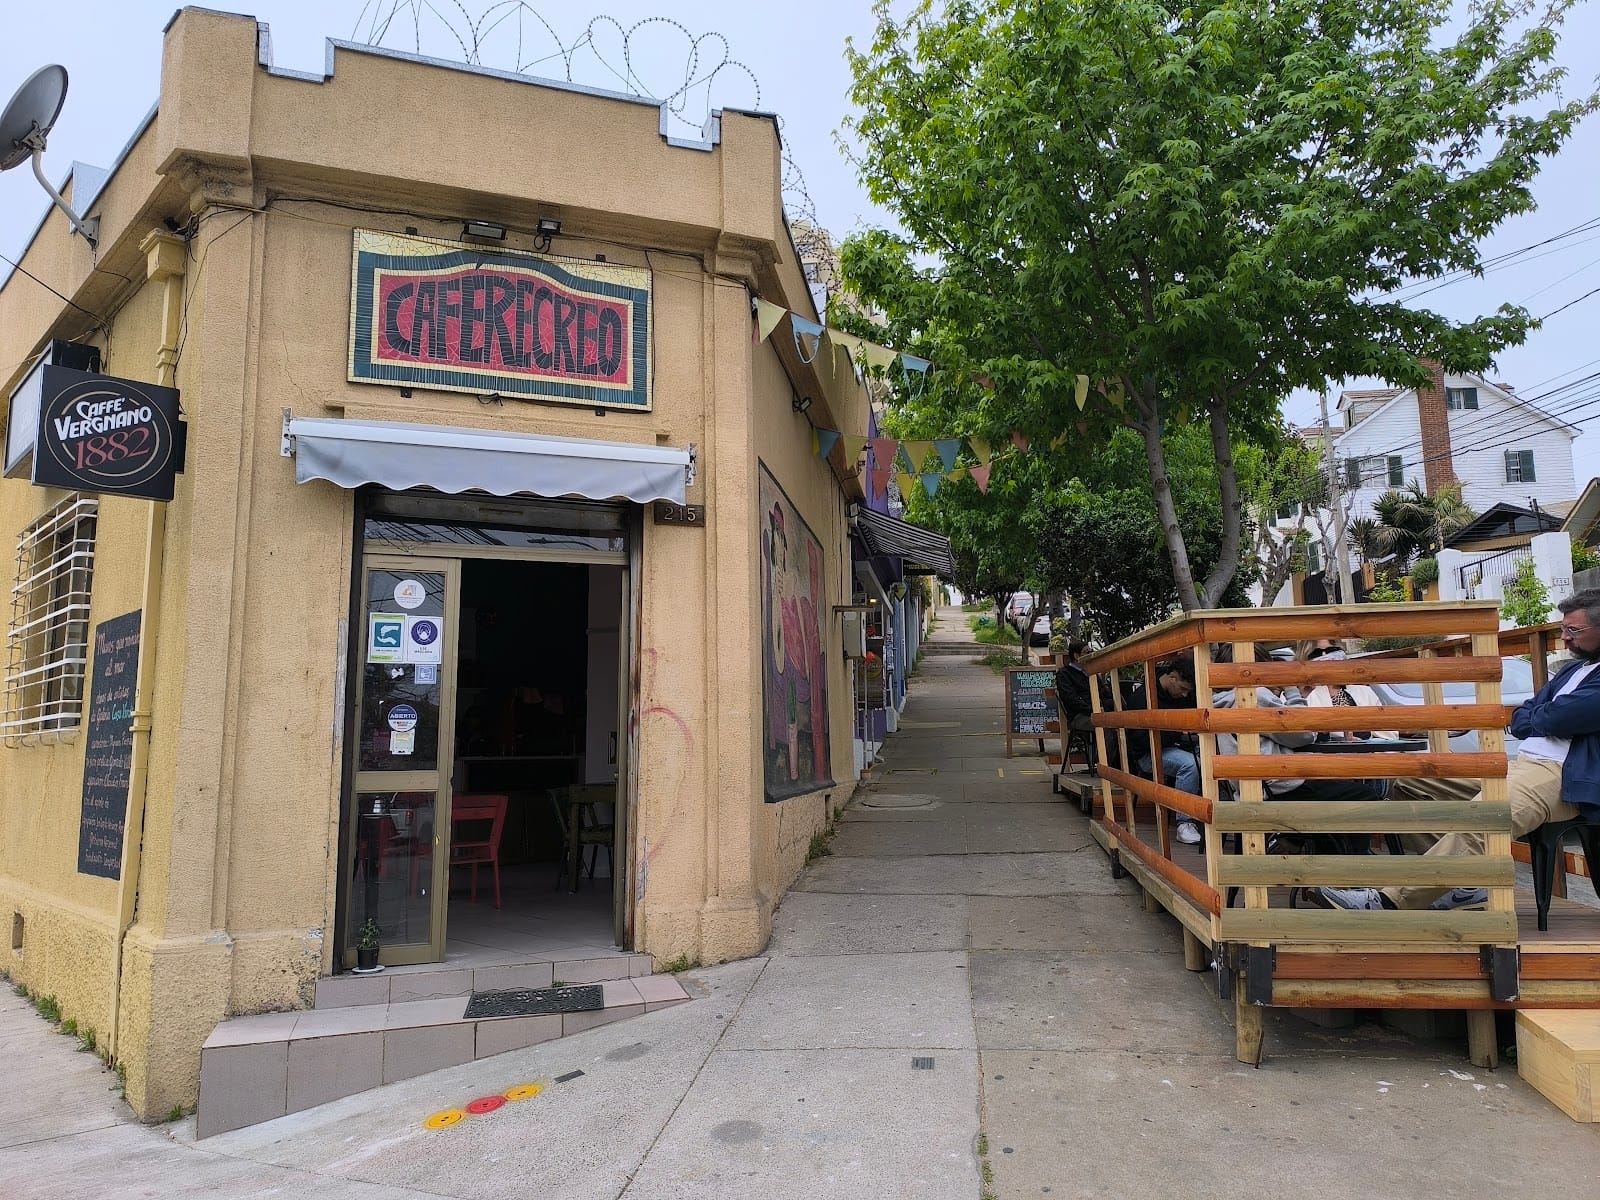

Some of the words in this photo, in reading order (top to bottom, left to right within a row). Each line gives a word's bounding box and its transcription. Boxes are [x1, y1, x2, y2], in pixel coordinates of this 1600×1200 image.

[54, 406, 152, 441] VERGNANO
[75, 427, 150, 470] 1882
[664, 506, 696, 521] 215
[1018, 702, 1047, 710] DULCES
